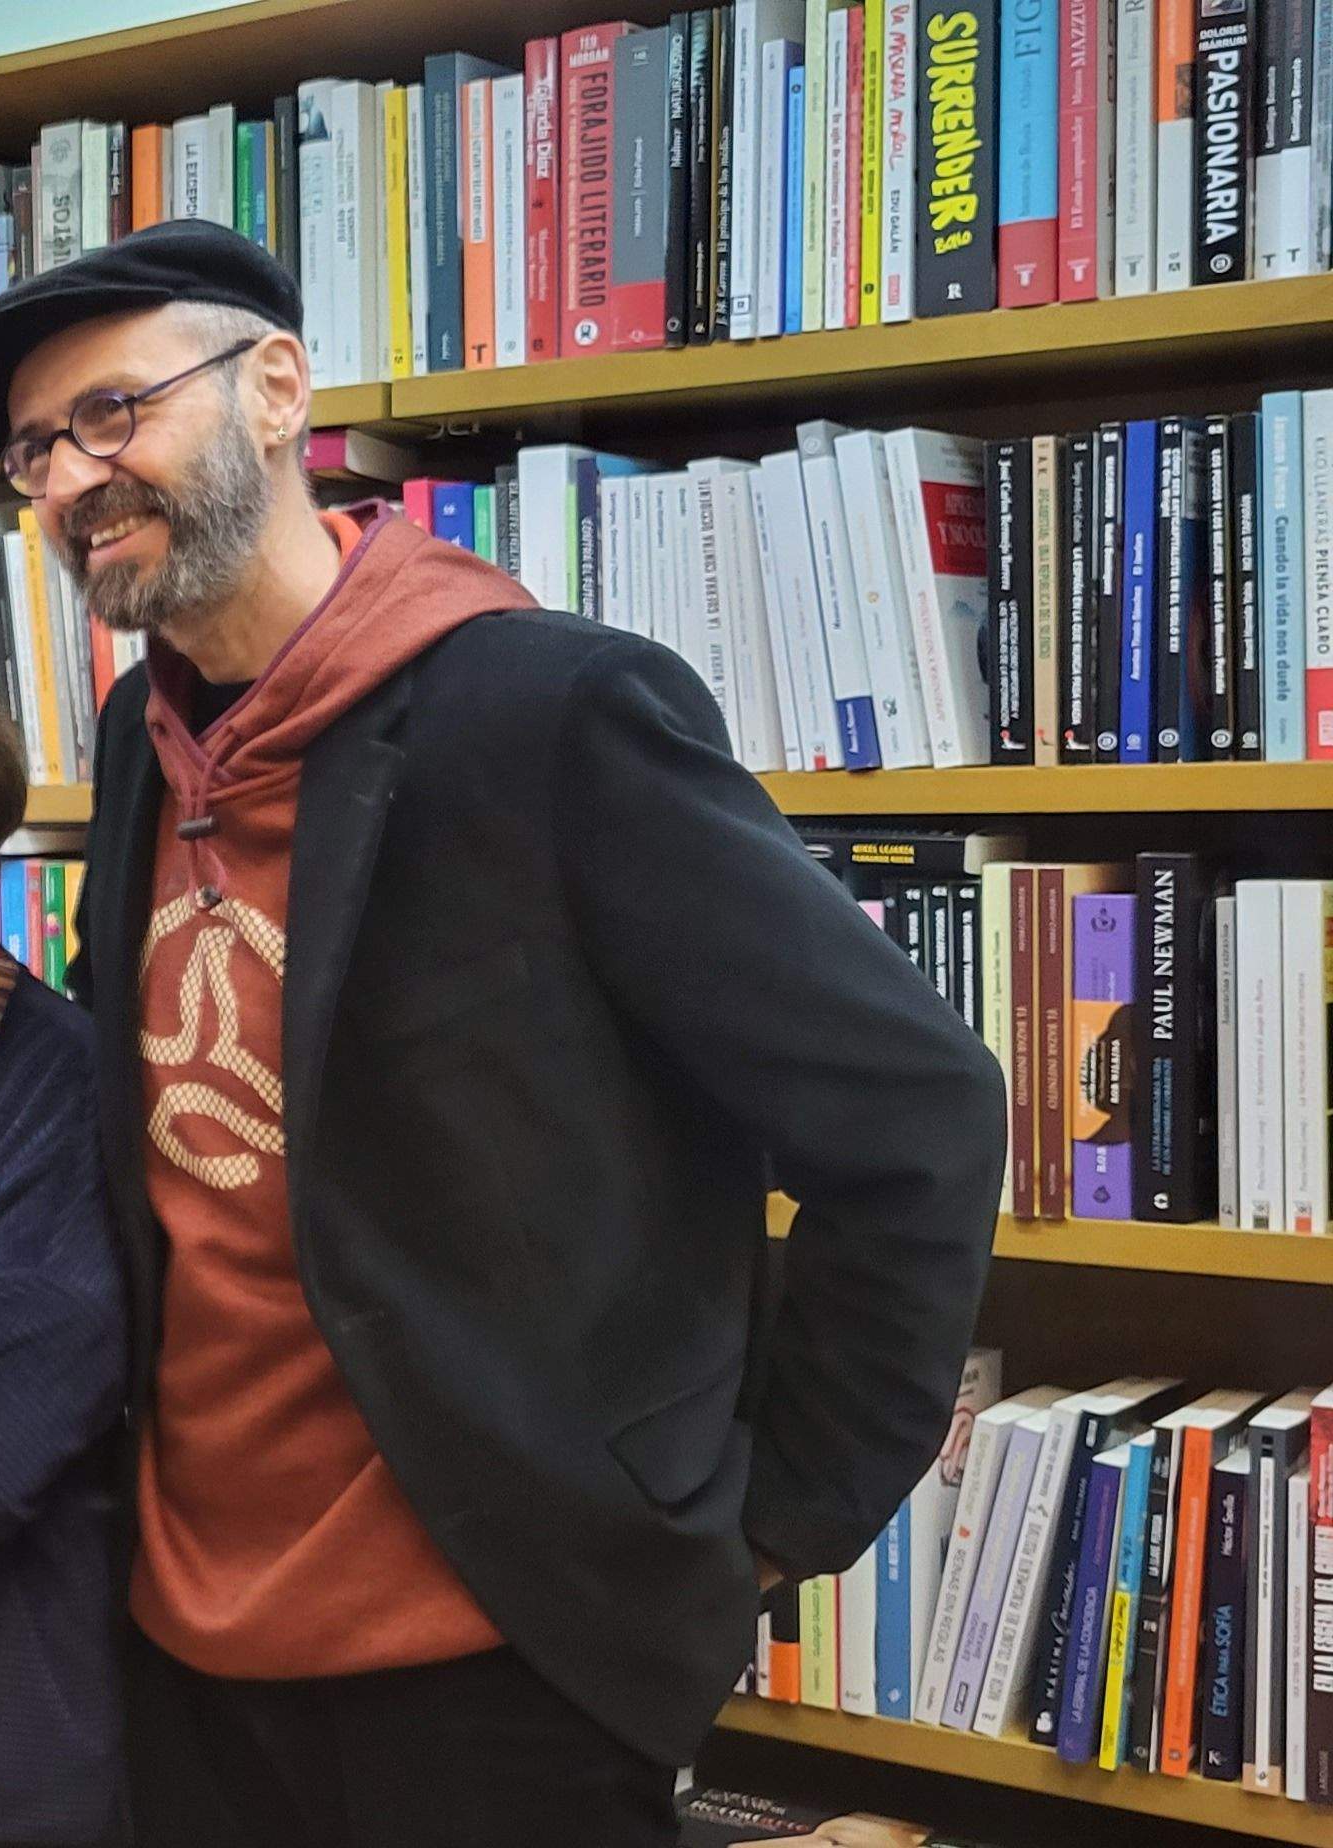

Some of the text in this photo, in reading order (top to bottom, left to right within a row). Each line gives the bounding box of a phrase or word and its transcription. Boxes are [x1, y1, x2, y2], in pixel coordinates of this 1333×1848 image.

[186, 143, 199, 161] LA
[927, 11, 983, 231] SURRENDER
[1205, 50, 1240, 245] PASIONARIA
[579, 71, 608, 309] FORAJIDO LITERARIO
[1315, 436, 1329, 473] KIKO
[702, 535, 718, 573] CONTRA
[705, 576, 721, 614] GUERRA
[708, 617, 721, 630] LA
[1274, 515, 1290, 702] Cuando la vida nos duele
[1316, 548, 1330, 655] PIENSA CLARO
[1153, 869, 1175, 1041] PAUL NEWMAN
[1071, 1586, 1100, 1725] LA ESPIRAL DE LA CONCIENCIA
[1212, 1604, 1233, 1648] SOFÍA
[1044, 1636, 1065, 1700] MÁXIMA
[1208, 1676, 1230, 1718] ÉTICA
